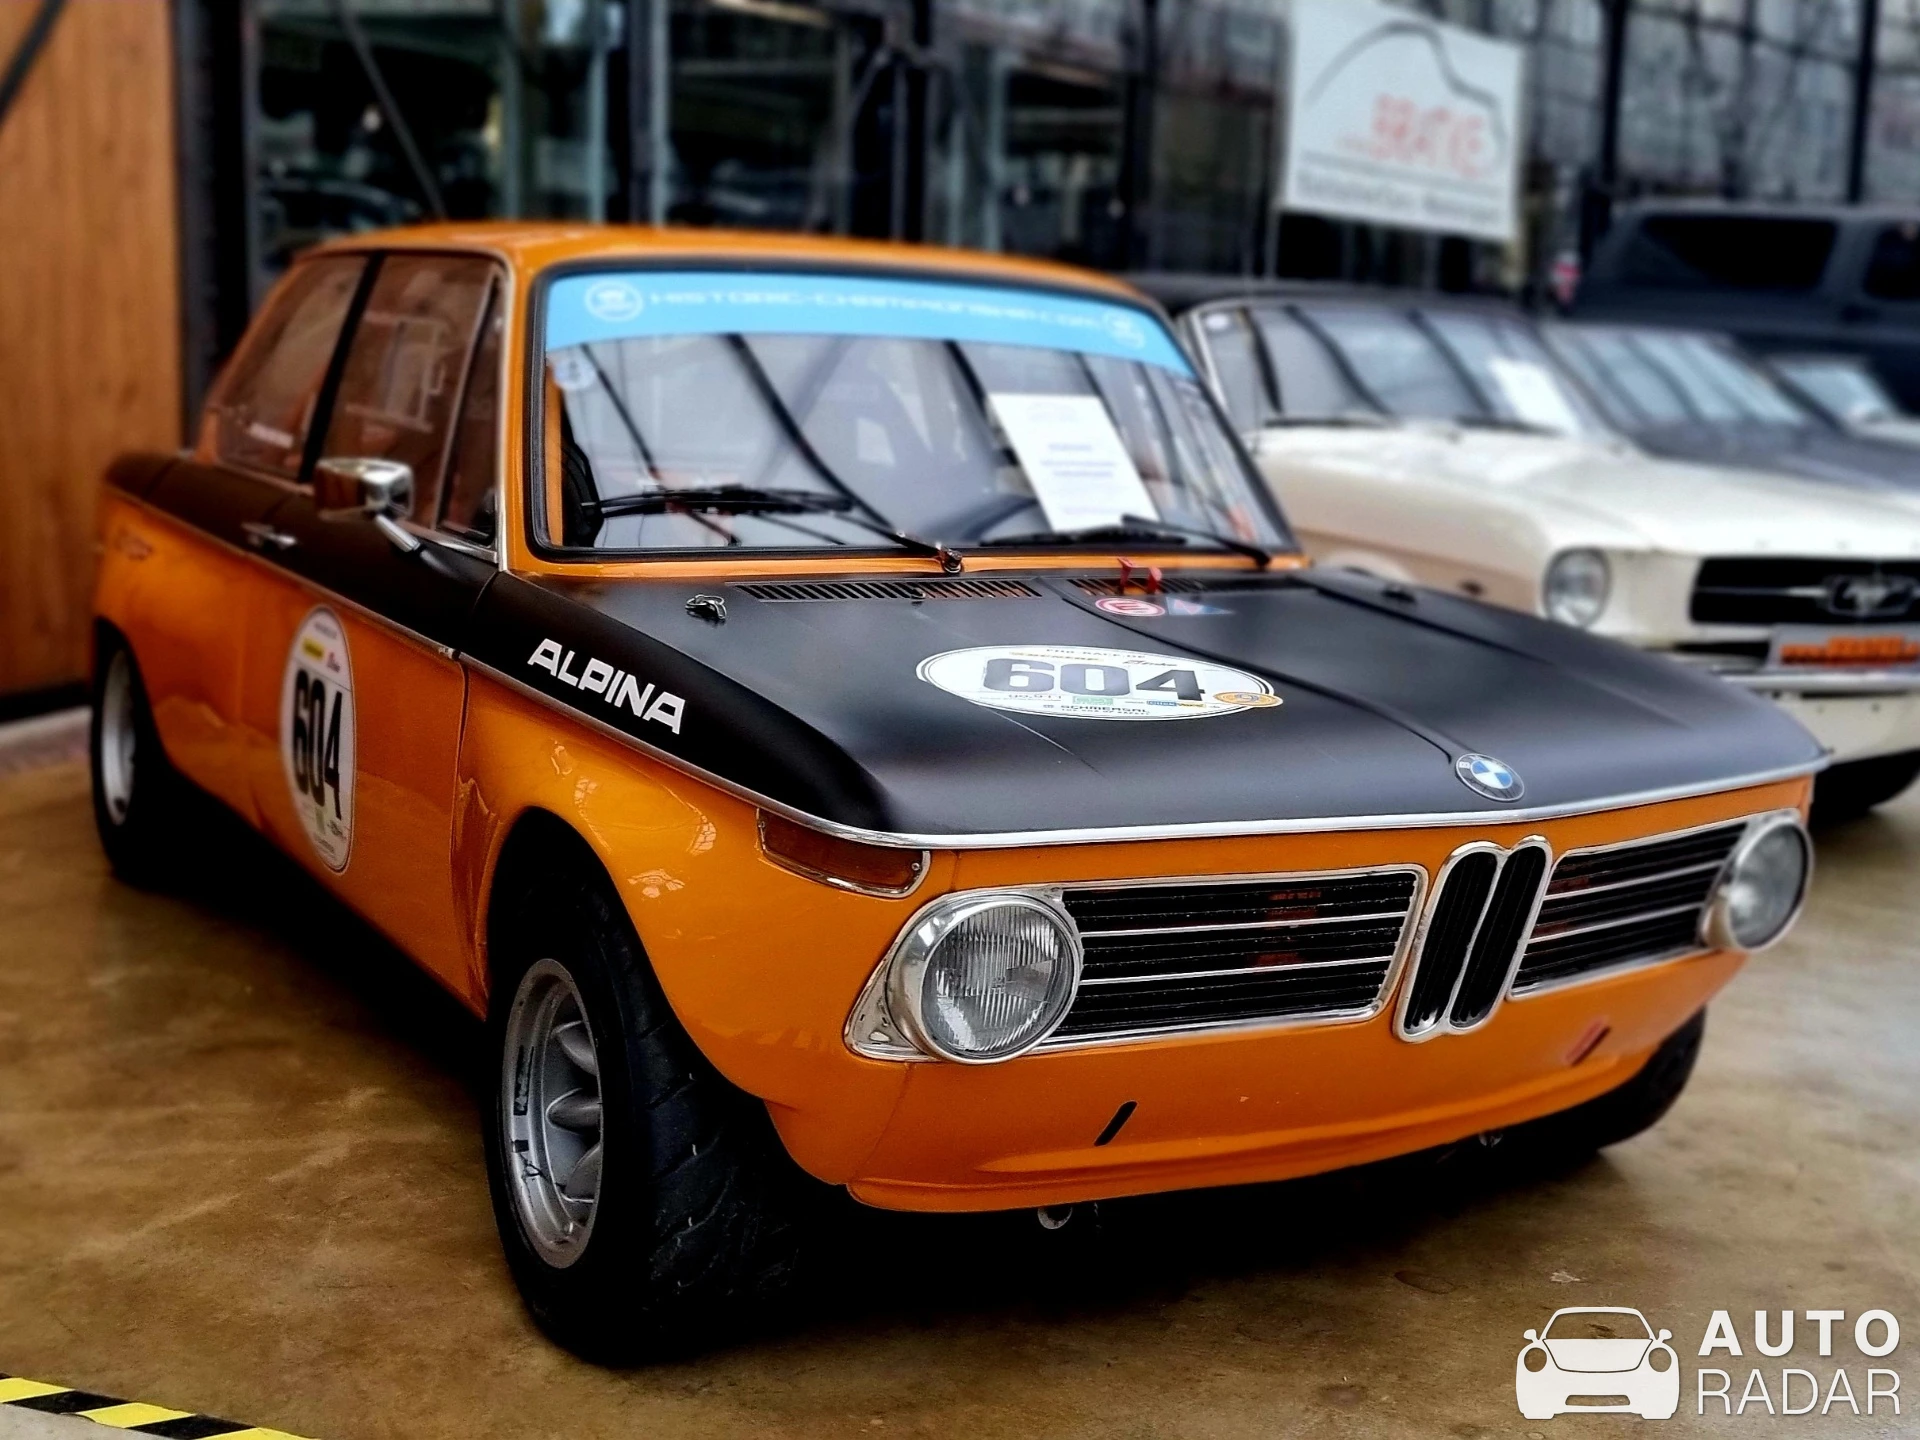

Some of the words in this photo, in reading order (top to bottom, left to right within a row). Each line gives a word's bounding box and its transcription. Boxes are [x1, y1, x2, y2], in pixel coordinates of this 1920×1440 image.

[527, 638, 686, 735] ALPINA
[983, 658, 1205, 701] 604
[292, 669, 343, 821] 604
